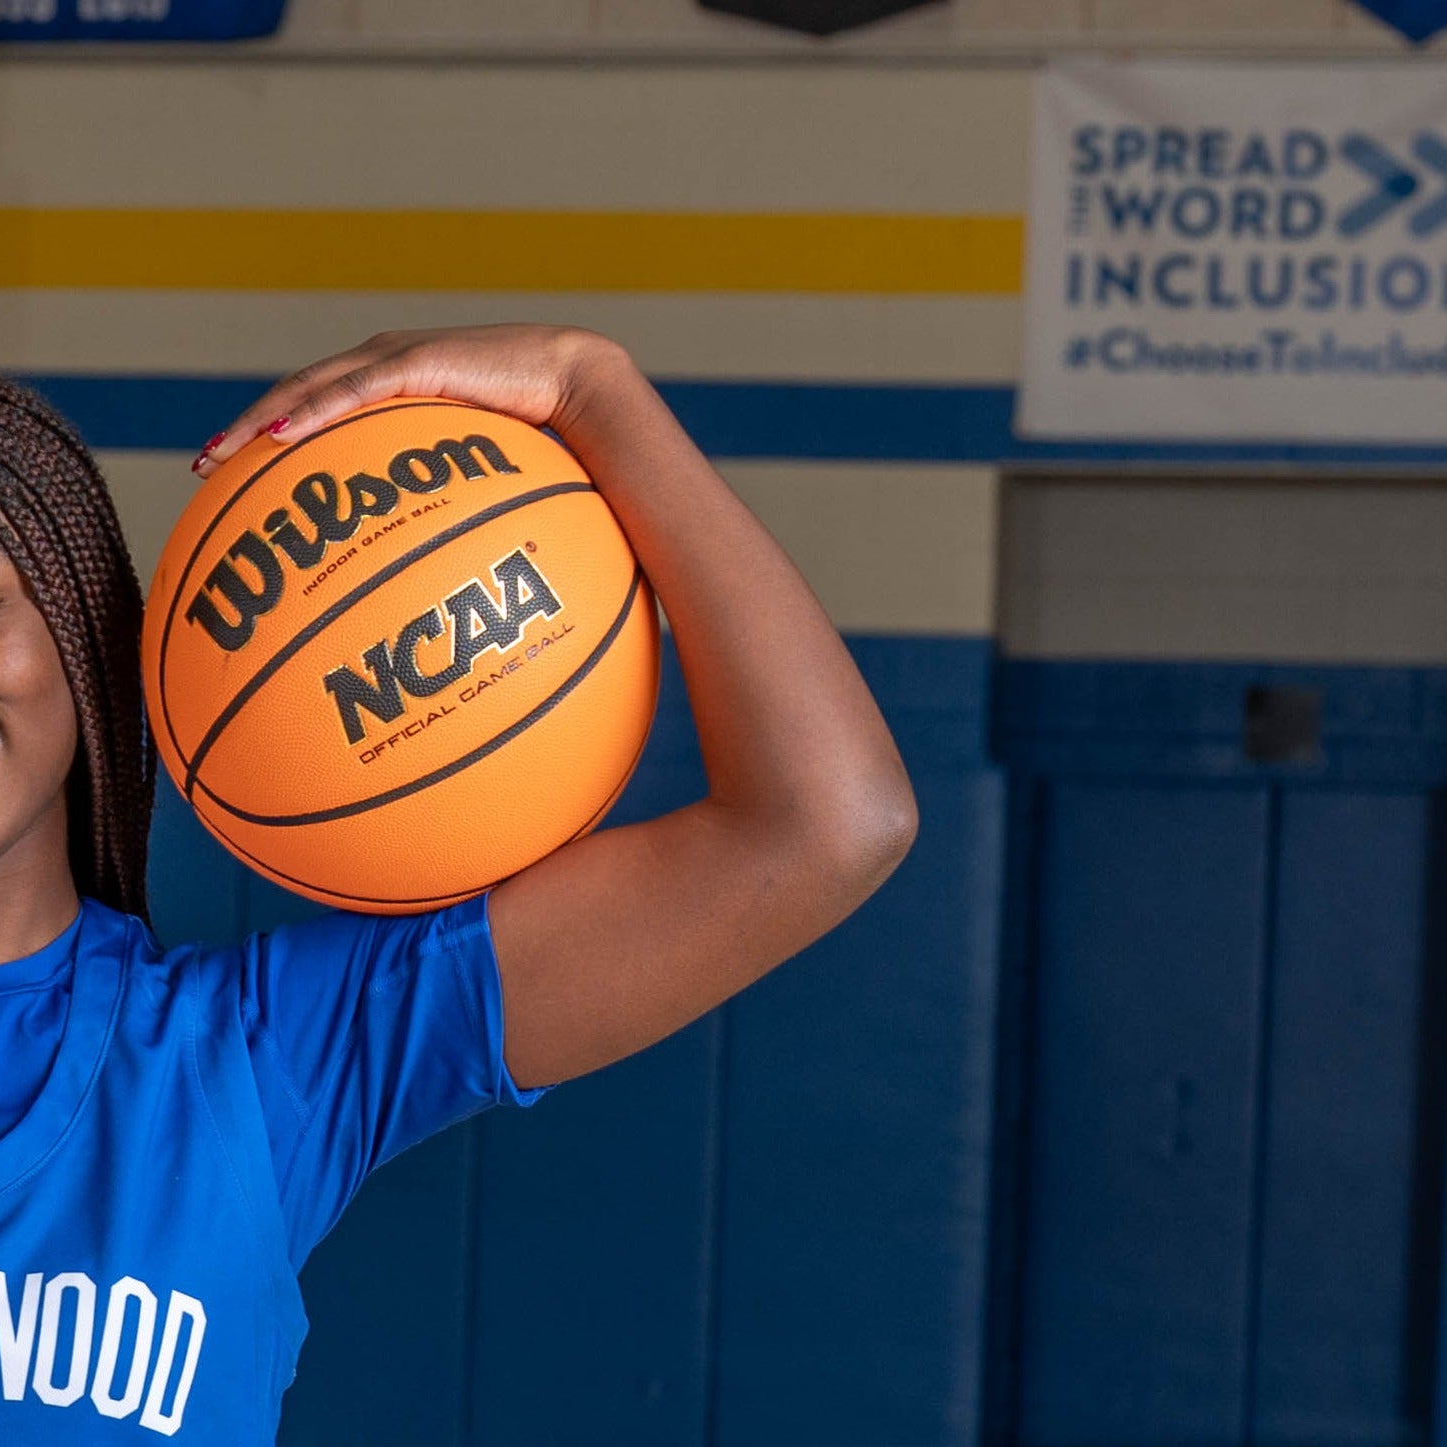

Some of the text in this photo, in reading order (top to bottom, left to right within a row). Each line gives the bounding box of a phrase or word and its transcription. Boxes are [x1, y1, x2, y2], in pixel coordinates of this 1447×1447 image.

[1073, 126, 1329, 178] SPREAD
[1102, 186, 1325, 240] WORD
[1065, 252, 1447, 313] INCLUSIO
[185, 434, 521, 653] Wilson
[302, 497, 451, 597] INDOOR GAME BALL
[321, 546, 564, 747] NCAA
[358, 622, 576, 766] OFFICIAL GAME BALL
